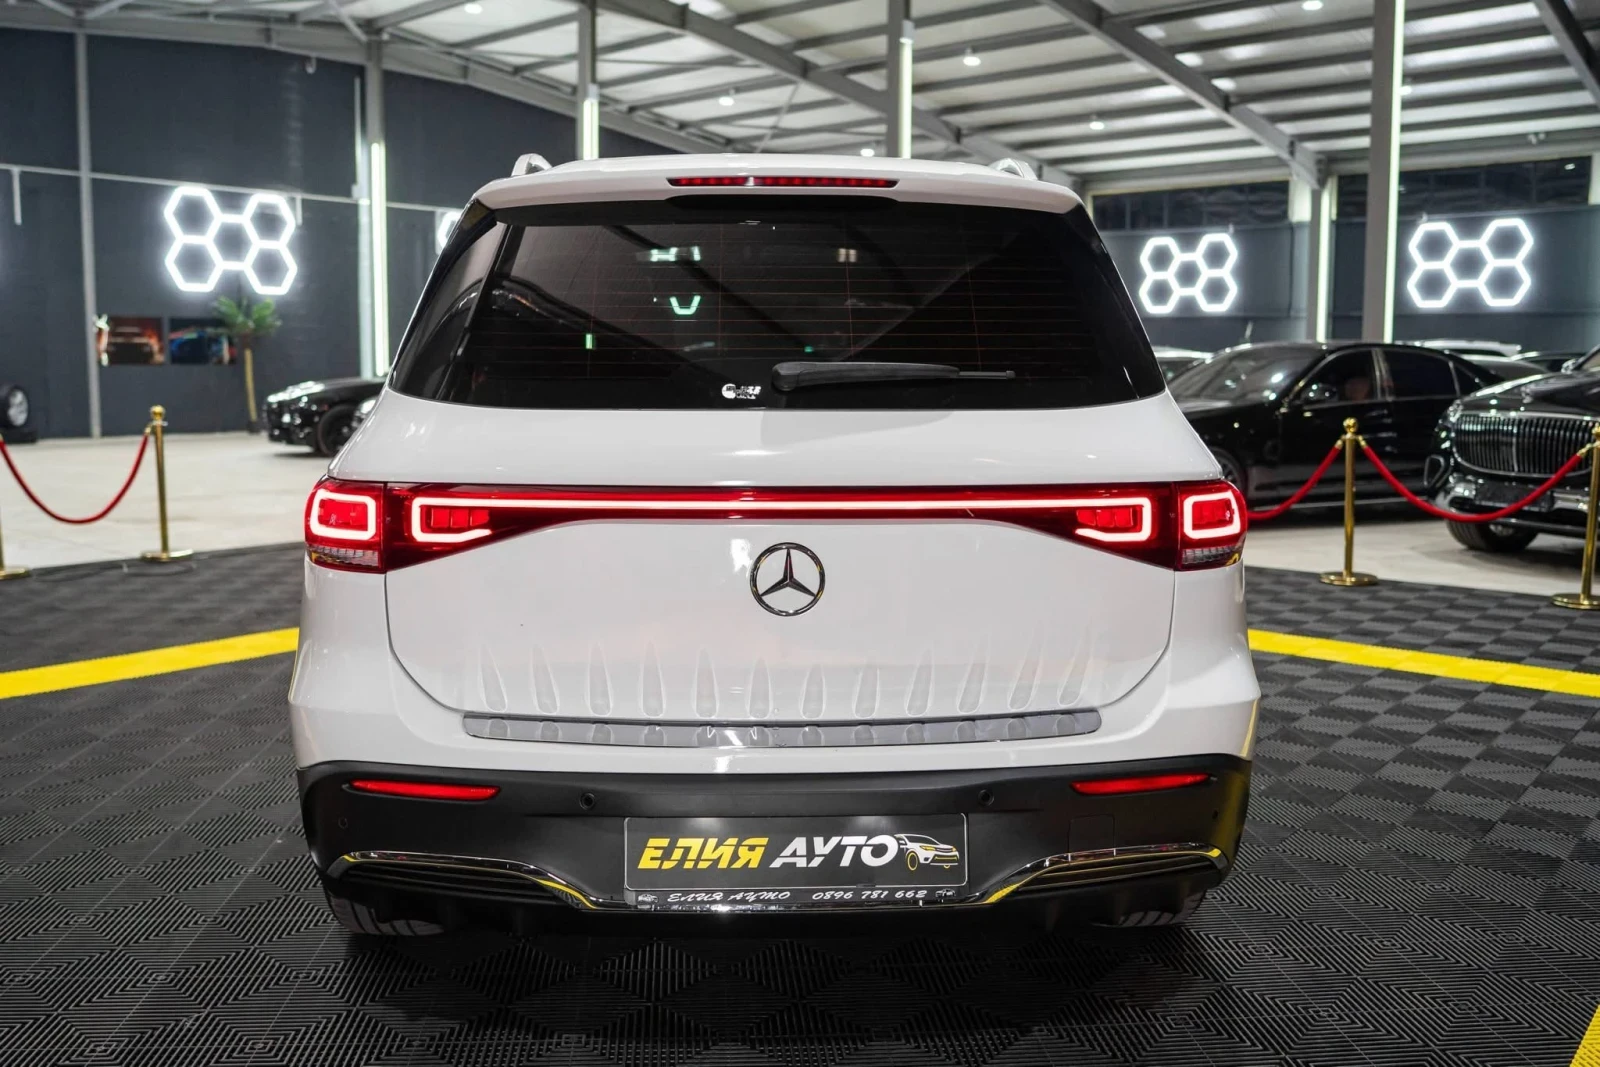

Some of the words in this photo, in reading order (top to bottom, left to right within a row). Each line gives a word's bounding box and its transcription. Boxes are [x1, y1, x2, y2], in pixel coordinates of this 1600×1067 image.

[637, 837, 769, 870] ЕЛИЯ
[769, 834, 899, 868] АУТО
[812, 891, 853, 900] 0896
[861, 890, 889, 899] 781
[894, 890, 928, 898] 662
